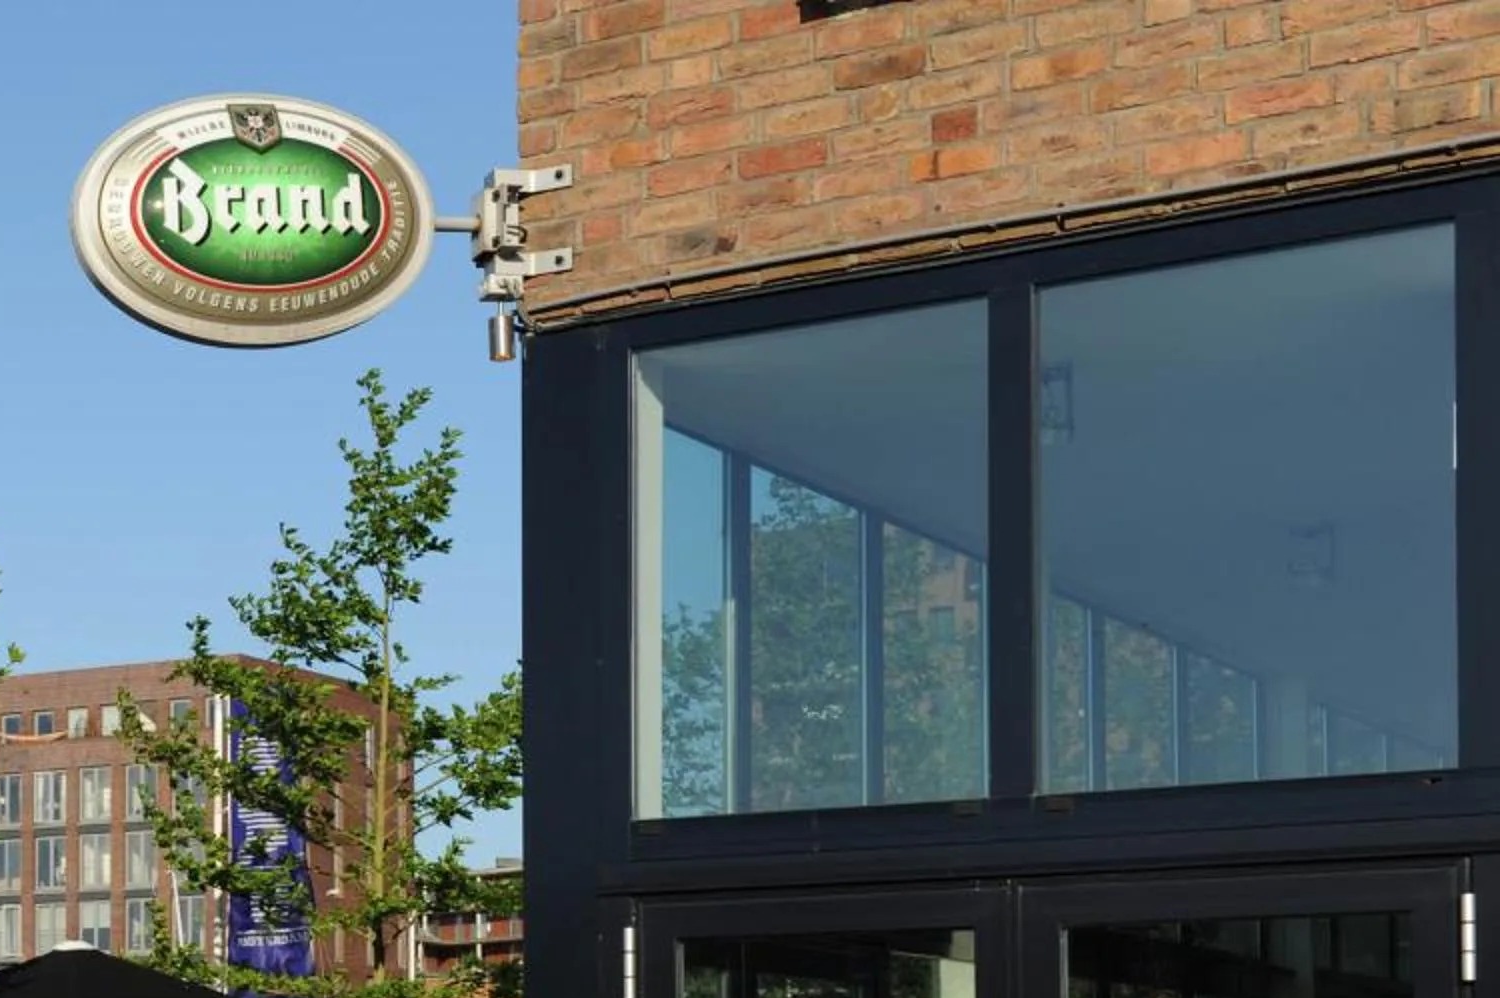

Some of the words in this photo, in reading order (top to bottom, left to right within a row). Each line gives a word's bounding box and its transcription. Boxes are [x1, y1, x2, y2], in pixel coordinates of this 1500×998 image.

[162, 157, 372, 246] Brand
[173, 278, 259, 313] VOLGENS
[269, 262, 381, 313] EEUWENOUDE
